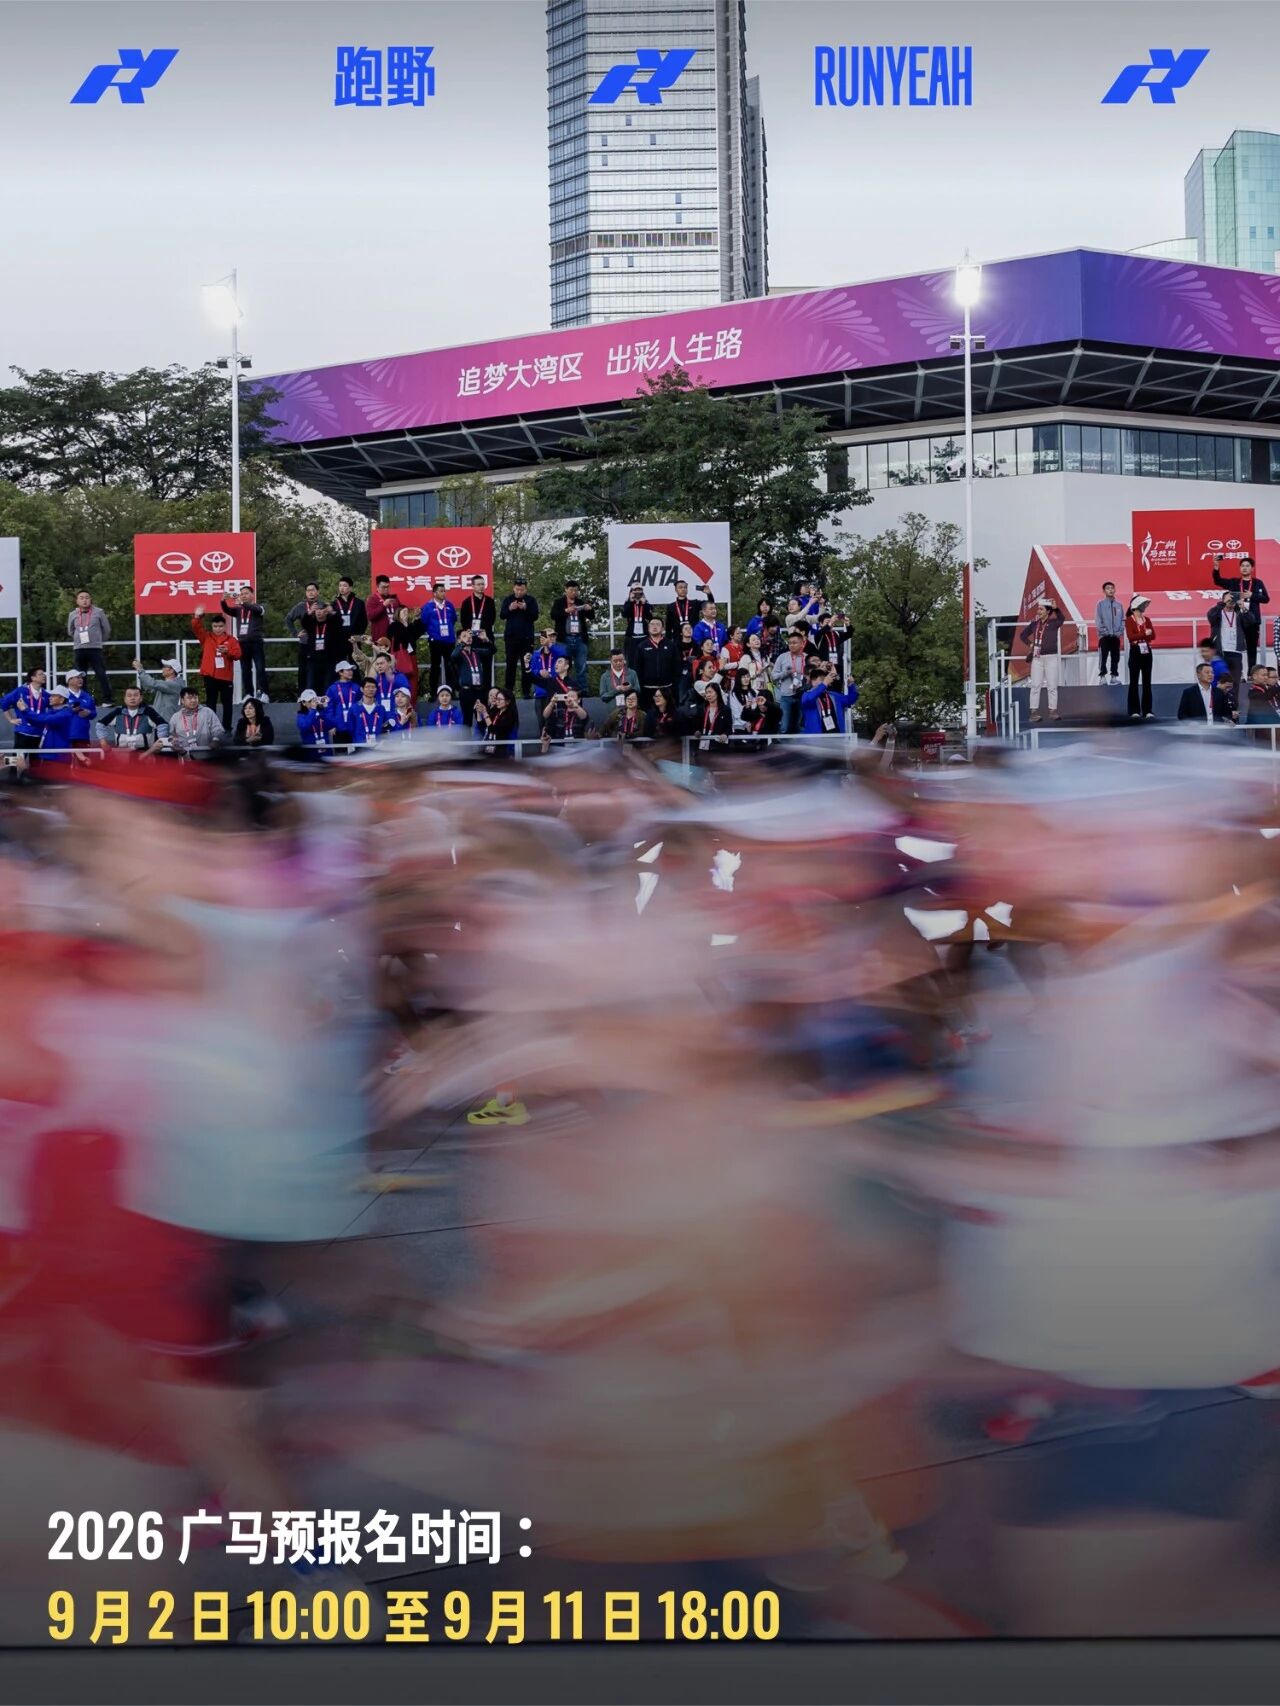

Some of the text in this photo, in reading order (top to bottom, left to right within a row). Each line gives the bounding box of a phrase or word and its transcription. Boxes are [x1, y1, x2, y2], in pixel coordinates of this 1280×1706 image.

[457, 327, 743, 398] 追梦大湾区 出彩人生路
[627, 565, 679, 587] ANTA
